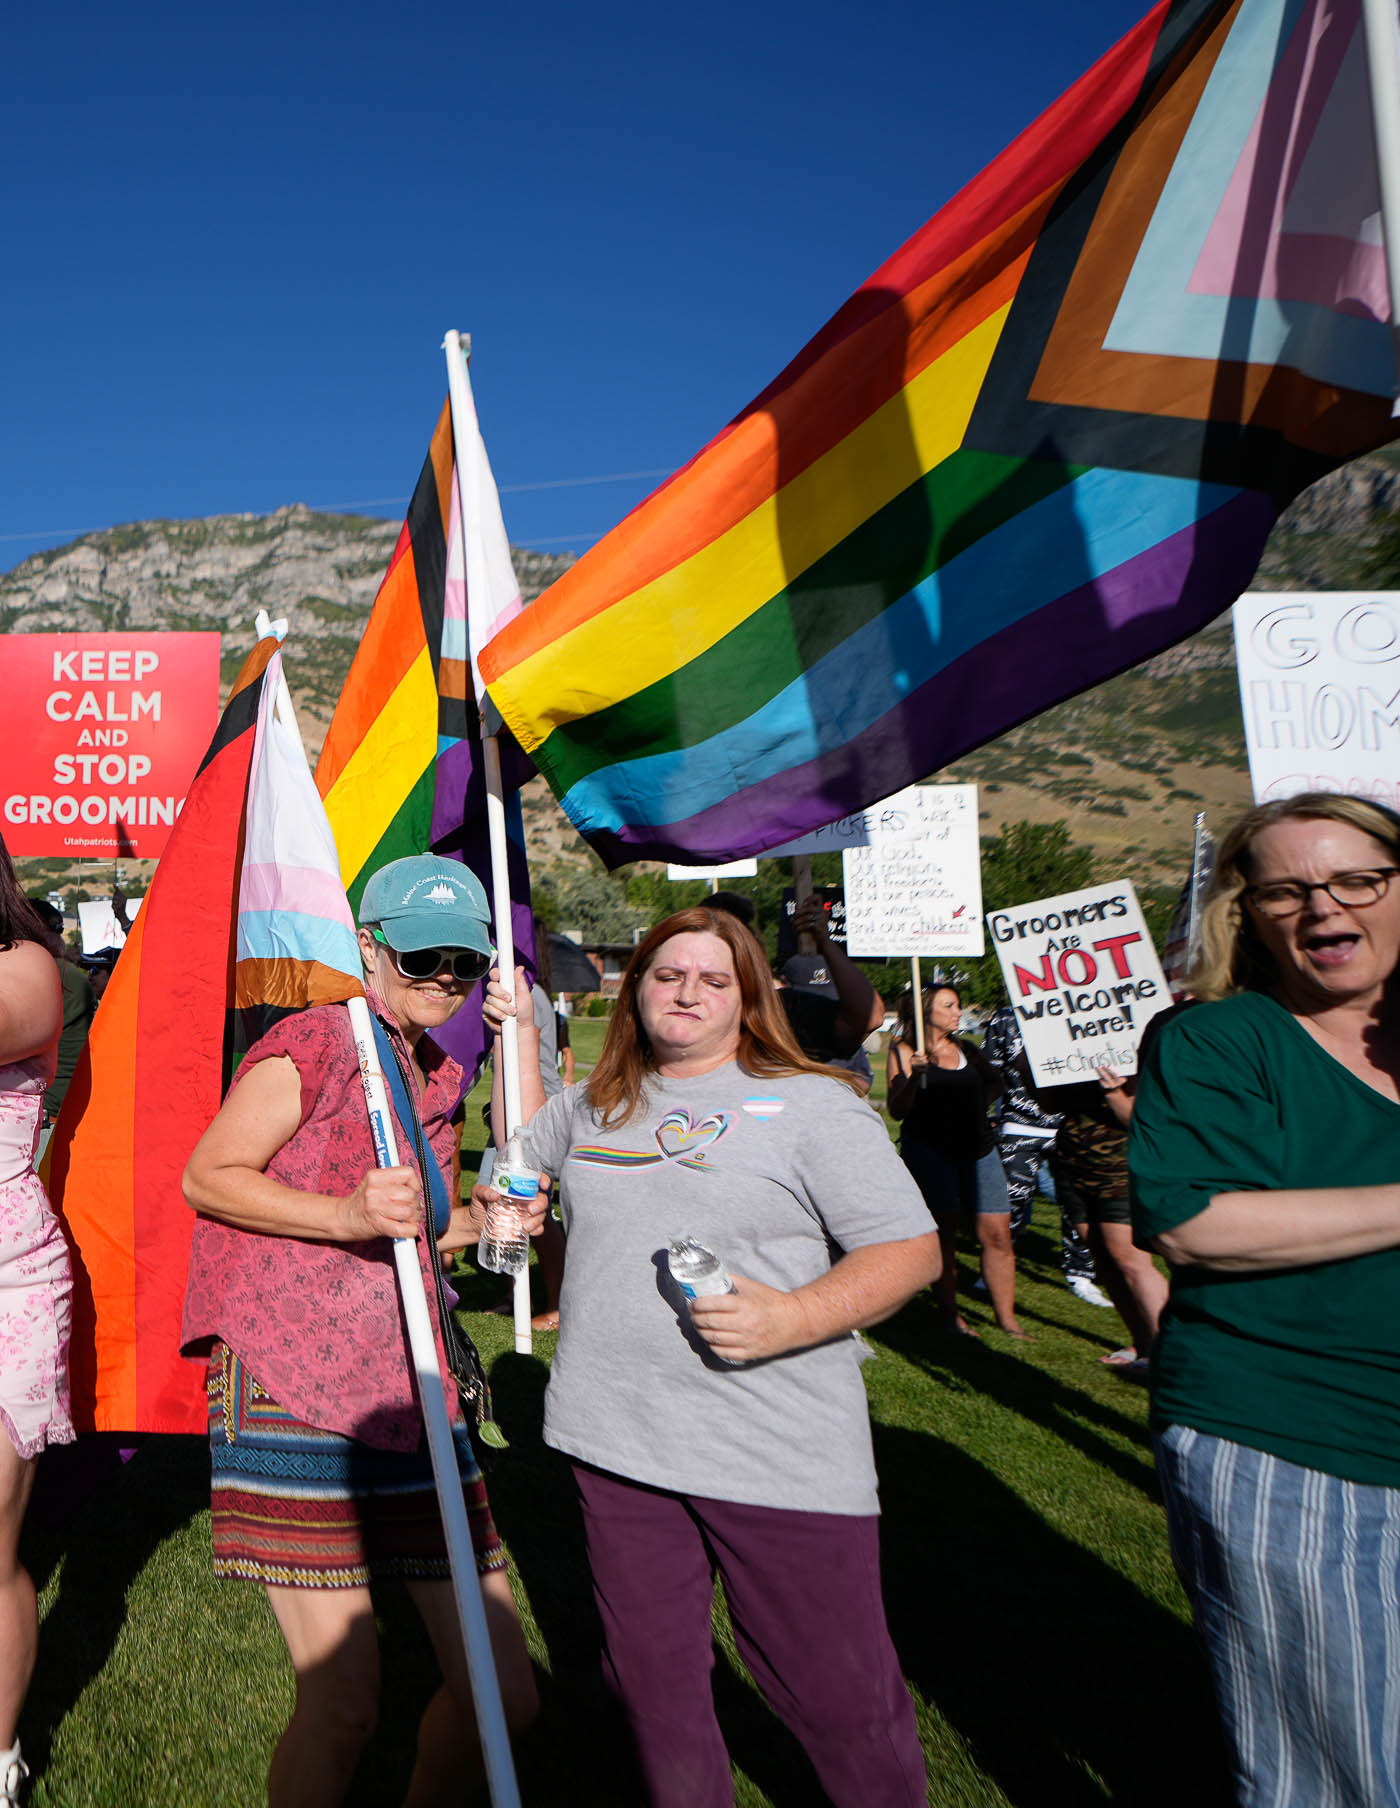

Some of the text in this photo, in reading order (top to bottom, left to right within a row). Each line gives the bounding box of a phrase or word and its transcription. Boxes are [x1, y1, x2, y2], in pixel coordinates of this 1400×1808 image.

[1250, 600, 1400, 670] GO
[52, 650, 160, 682] KEEP
[45, 690, 162, 723] CALM
[1249, 679, 1400, 752] HOM
[76, 728, 129, 748] AND
[52, 754, 152, 786] STOP
[63, 836, 139, 848] Utahpatriots.com
[401, 884, 417, 905] Maine
[416, 874, 437, 887] Coast
[991, 895, 1129, 943] Groomers
[1045, 933, 1082, 954] Are
[1012, 931, 1143, 997] NOT
[1015, 979, 1158, 1021] welcome
[1065, 1005, 1136, 1042] here!
[369, 1110, 386, 1149] Spread
